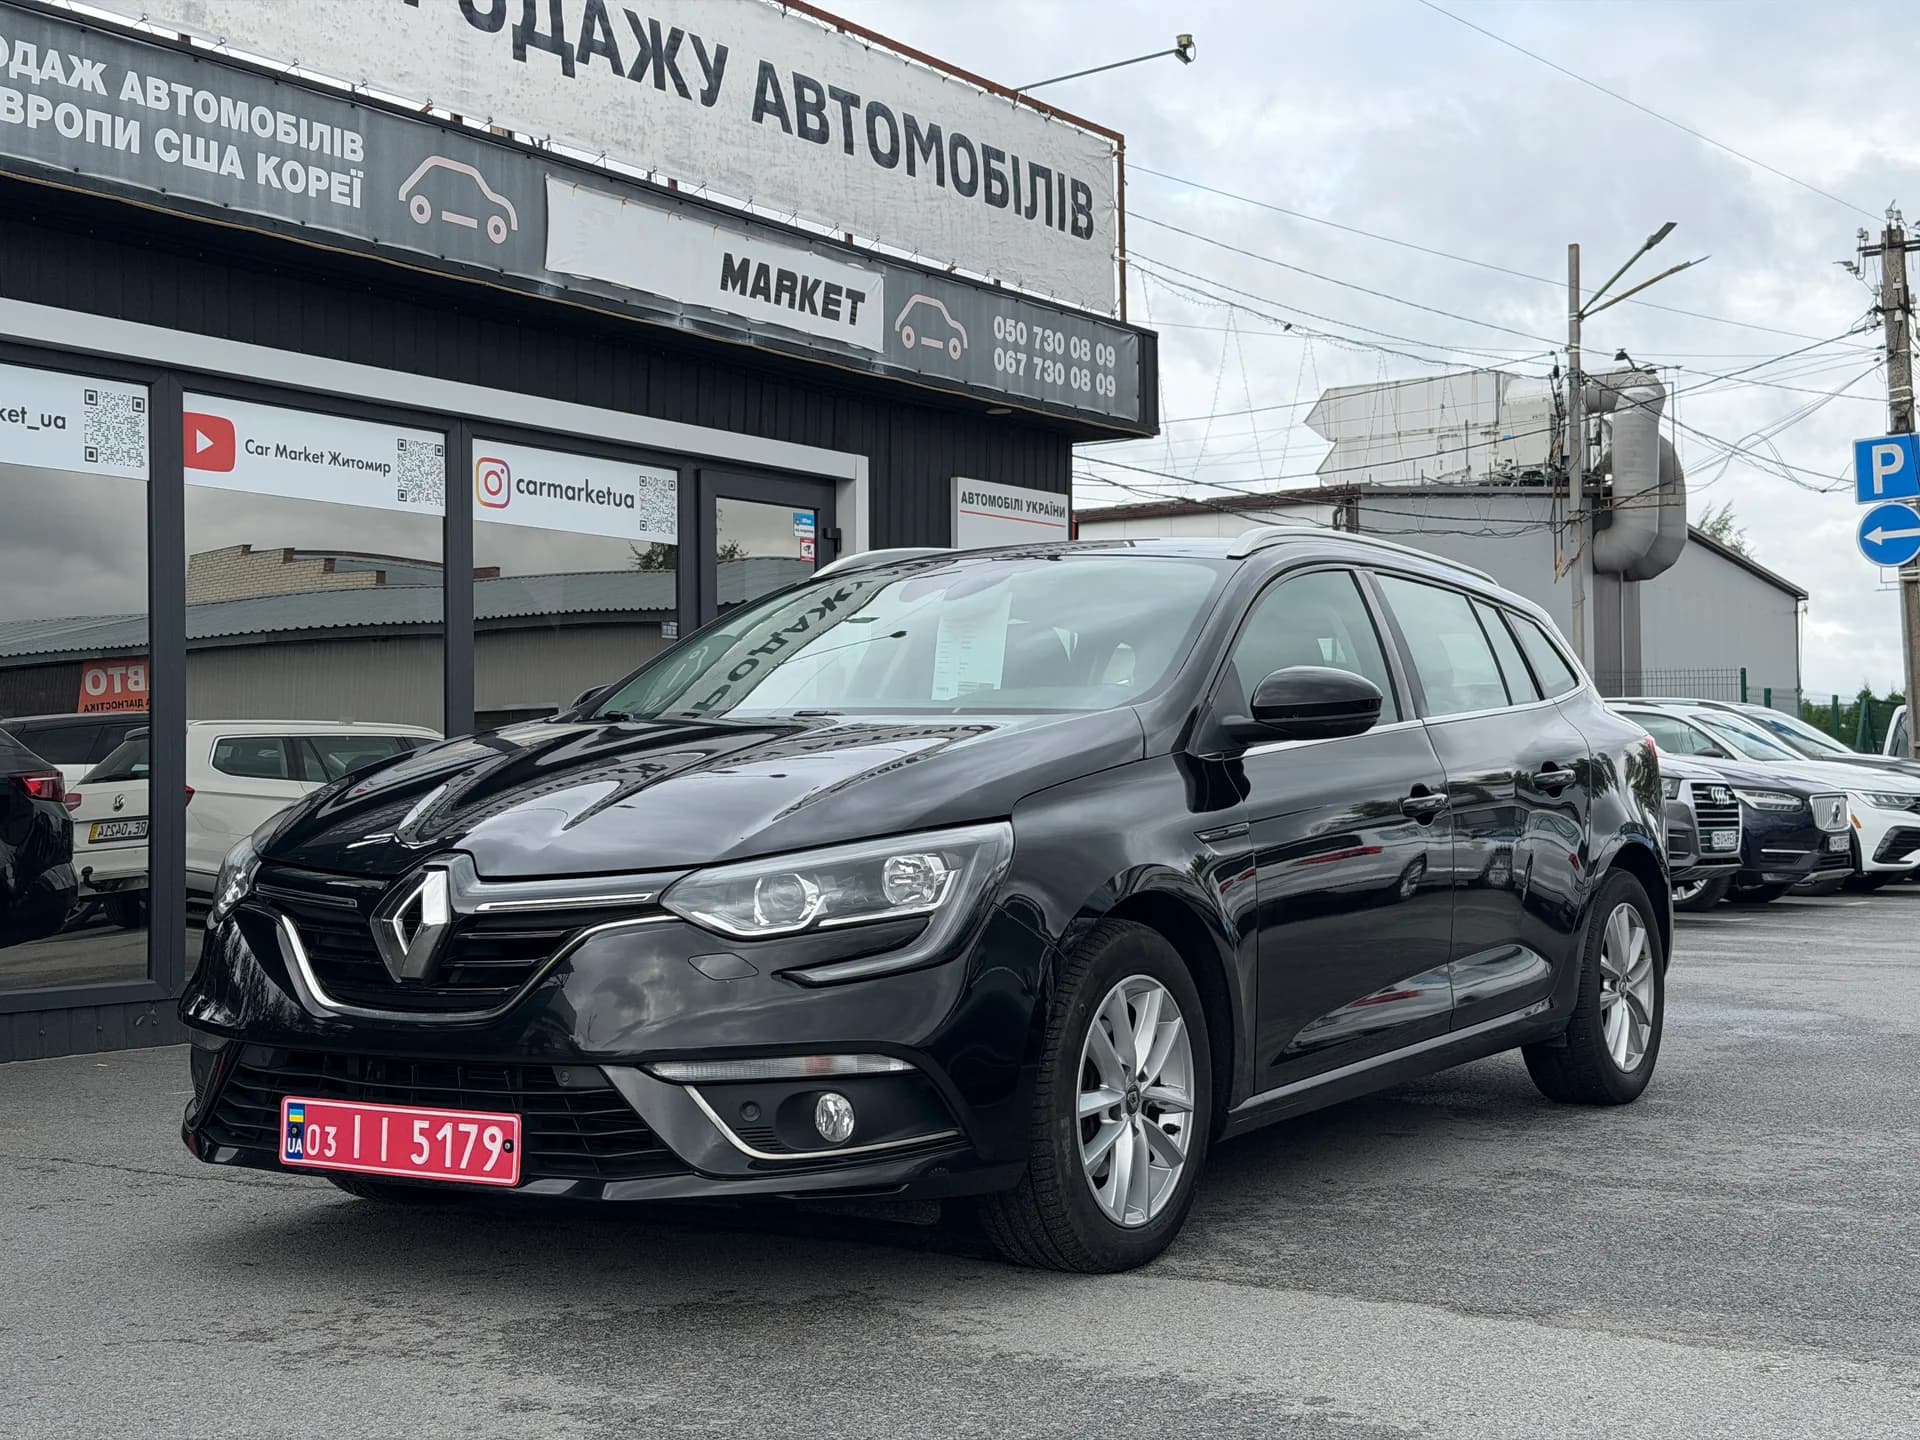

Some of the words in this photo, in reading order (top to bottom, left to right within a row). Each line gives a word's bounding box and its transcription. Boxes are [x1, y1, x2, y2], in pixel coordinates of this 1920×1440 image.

[119, 71, 364, 163] АВТОМОБІЛІВ
[403, 0, 729, 108] ДАЖУ
[752, 59, 1094, 240] АВТОМОБІЛІВ
[154, 128, 245, 180] США
[257, 152, 364, 209] КОРЕЇ
[720, 252, 866, 326] MARKET
[993, 315, 1028, 346] 050
[1032, 326, 1064, 355] 730
[1069, 335, 1091, 362] 08
[1095, 342, 1116, 368] 09
[993, 347, 1028, 376] 067
[1032, 357, 1064, 385] 730
[1070, 366, 1091, 392] 08
[1095, 372, 1116, 397] 09
[244, 438, 271, 457] Car
[274, 442, 325, 465] Market
[328, 449, 391, 475] Житомир
[1872, 444, 1904, 494] P
[516, 474, 635, 510] carmarketua
[961, 490, 1023, 512] АВТОМОБІЛІ
[1026, 499, 1066, 519] УКРАЇНИ
[288, 1137, 303, 1154] UA
[306, 1123, 337, 1157] 03
[410, 1119, 504, 1172] 5179
